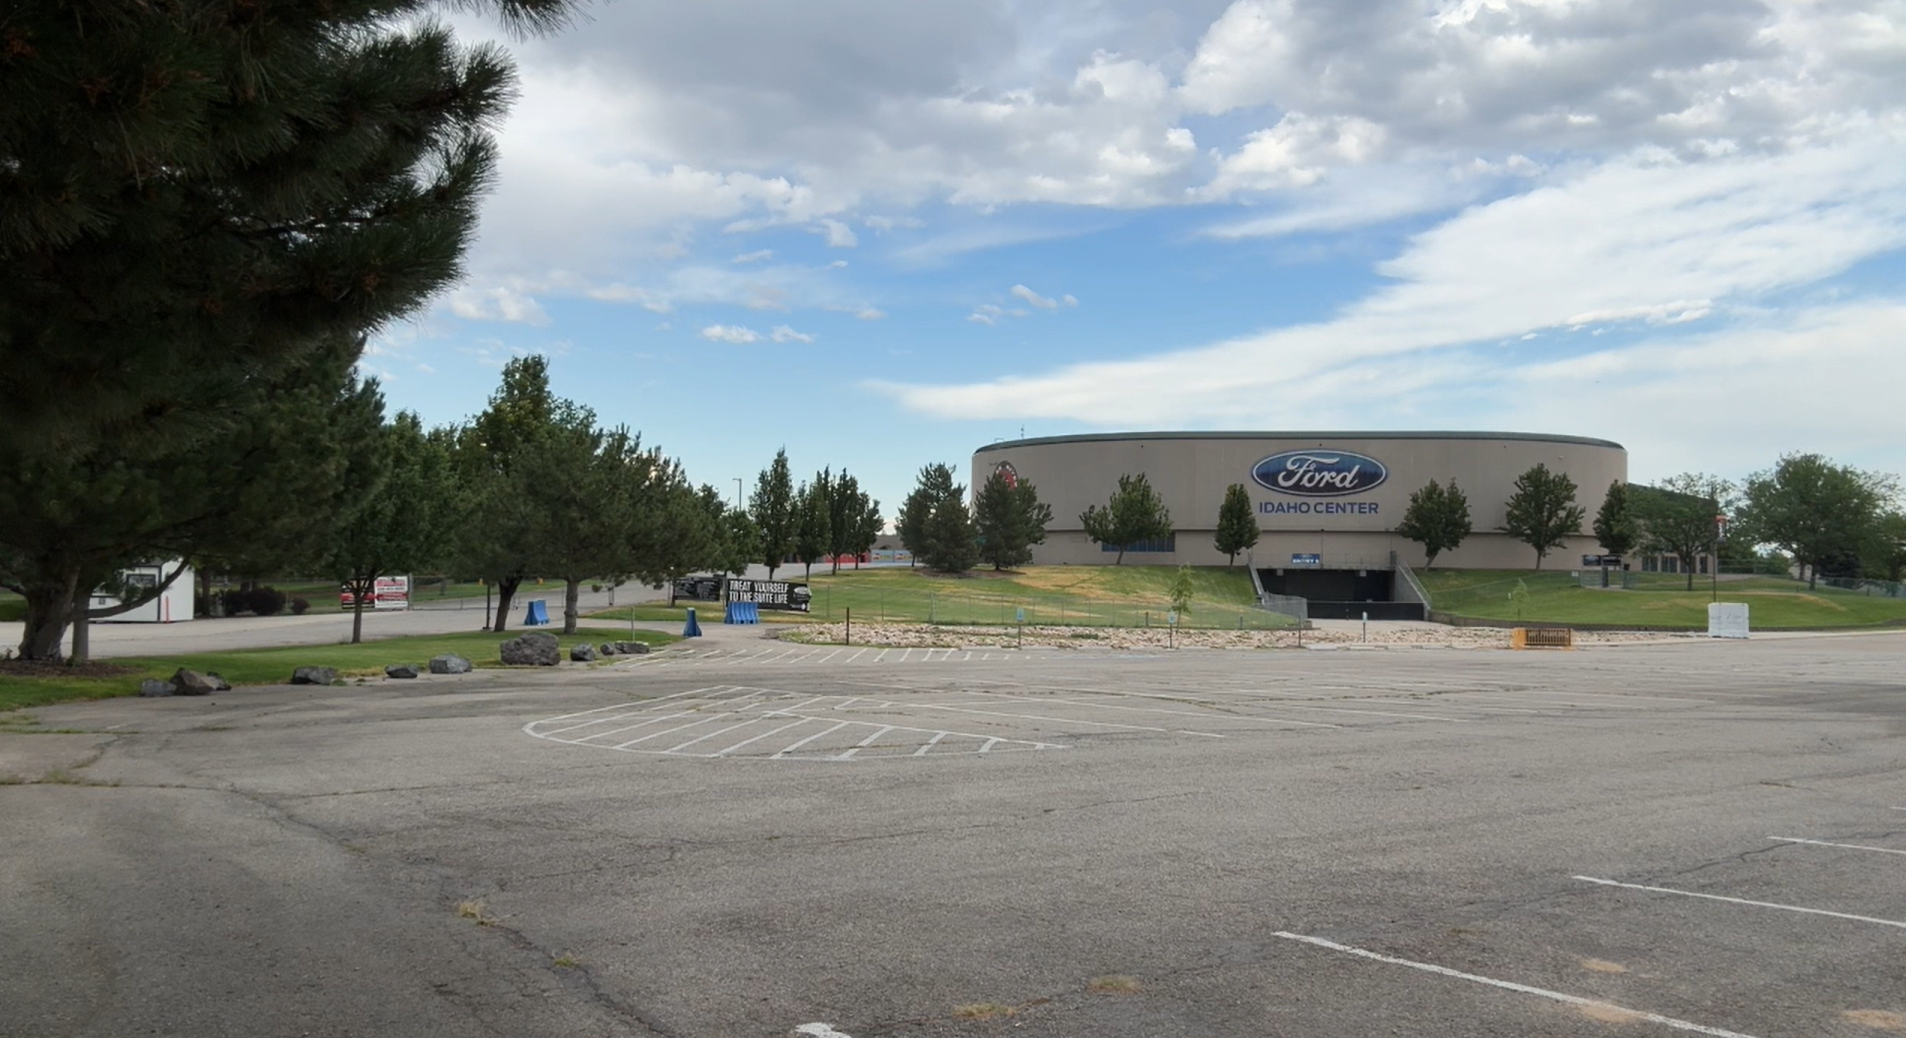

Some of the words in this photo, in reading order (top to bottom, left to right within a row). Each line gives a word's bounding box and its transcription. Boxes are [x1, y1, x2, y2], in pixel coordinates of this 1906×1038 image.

[1277, 455, 1361, 488] Ford
[1259, 502, 1310, 514] IDAHO
[1314, 502, 1379, 514] CENTER
[729, 580, 752, 591] TREAT
[754, 581, 789, 593] YOURSELF
[729, 591, 739, 602] TO
[740, 591, 752, 602] THE
[753, 592, 773, 604] SUITE
[774, 593, 788, 604] LIFE
